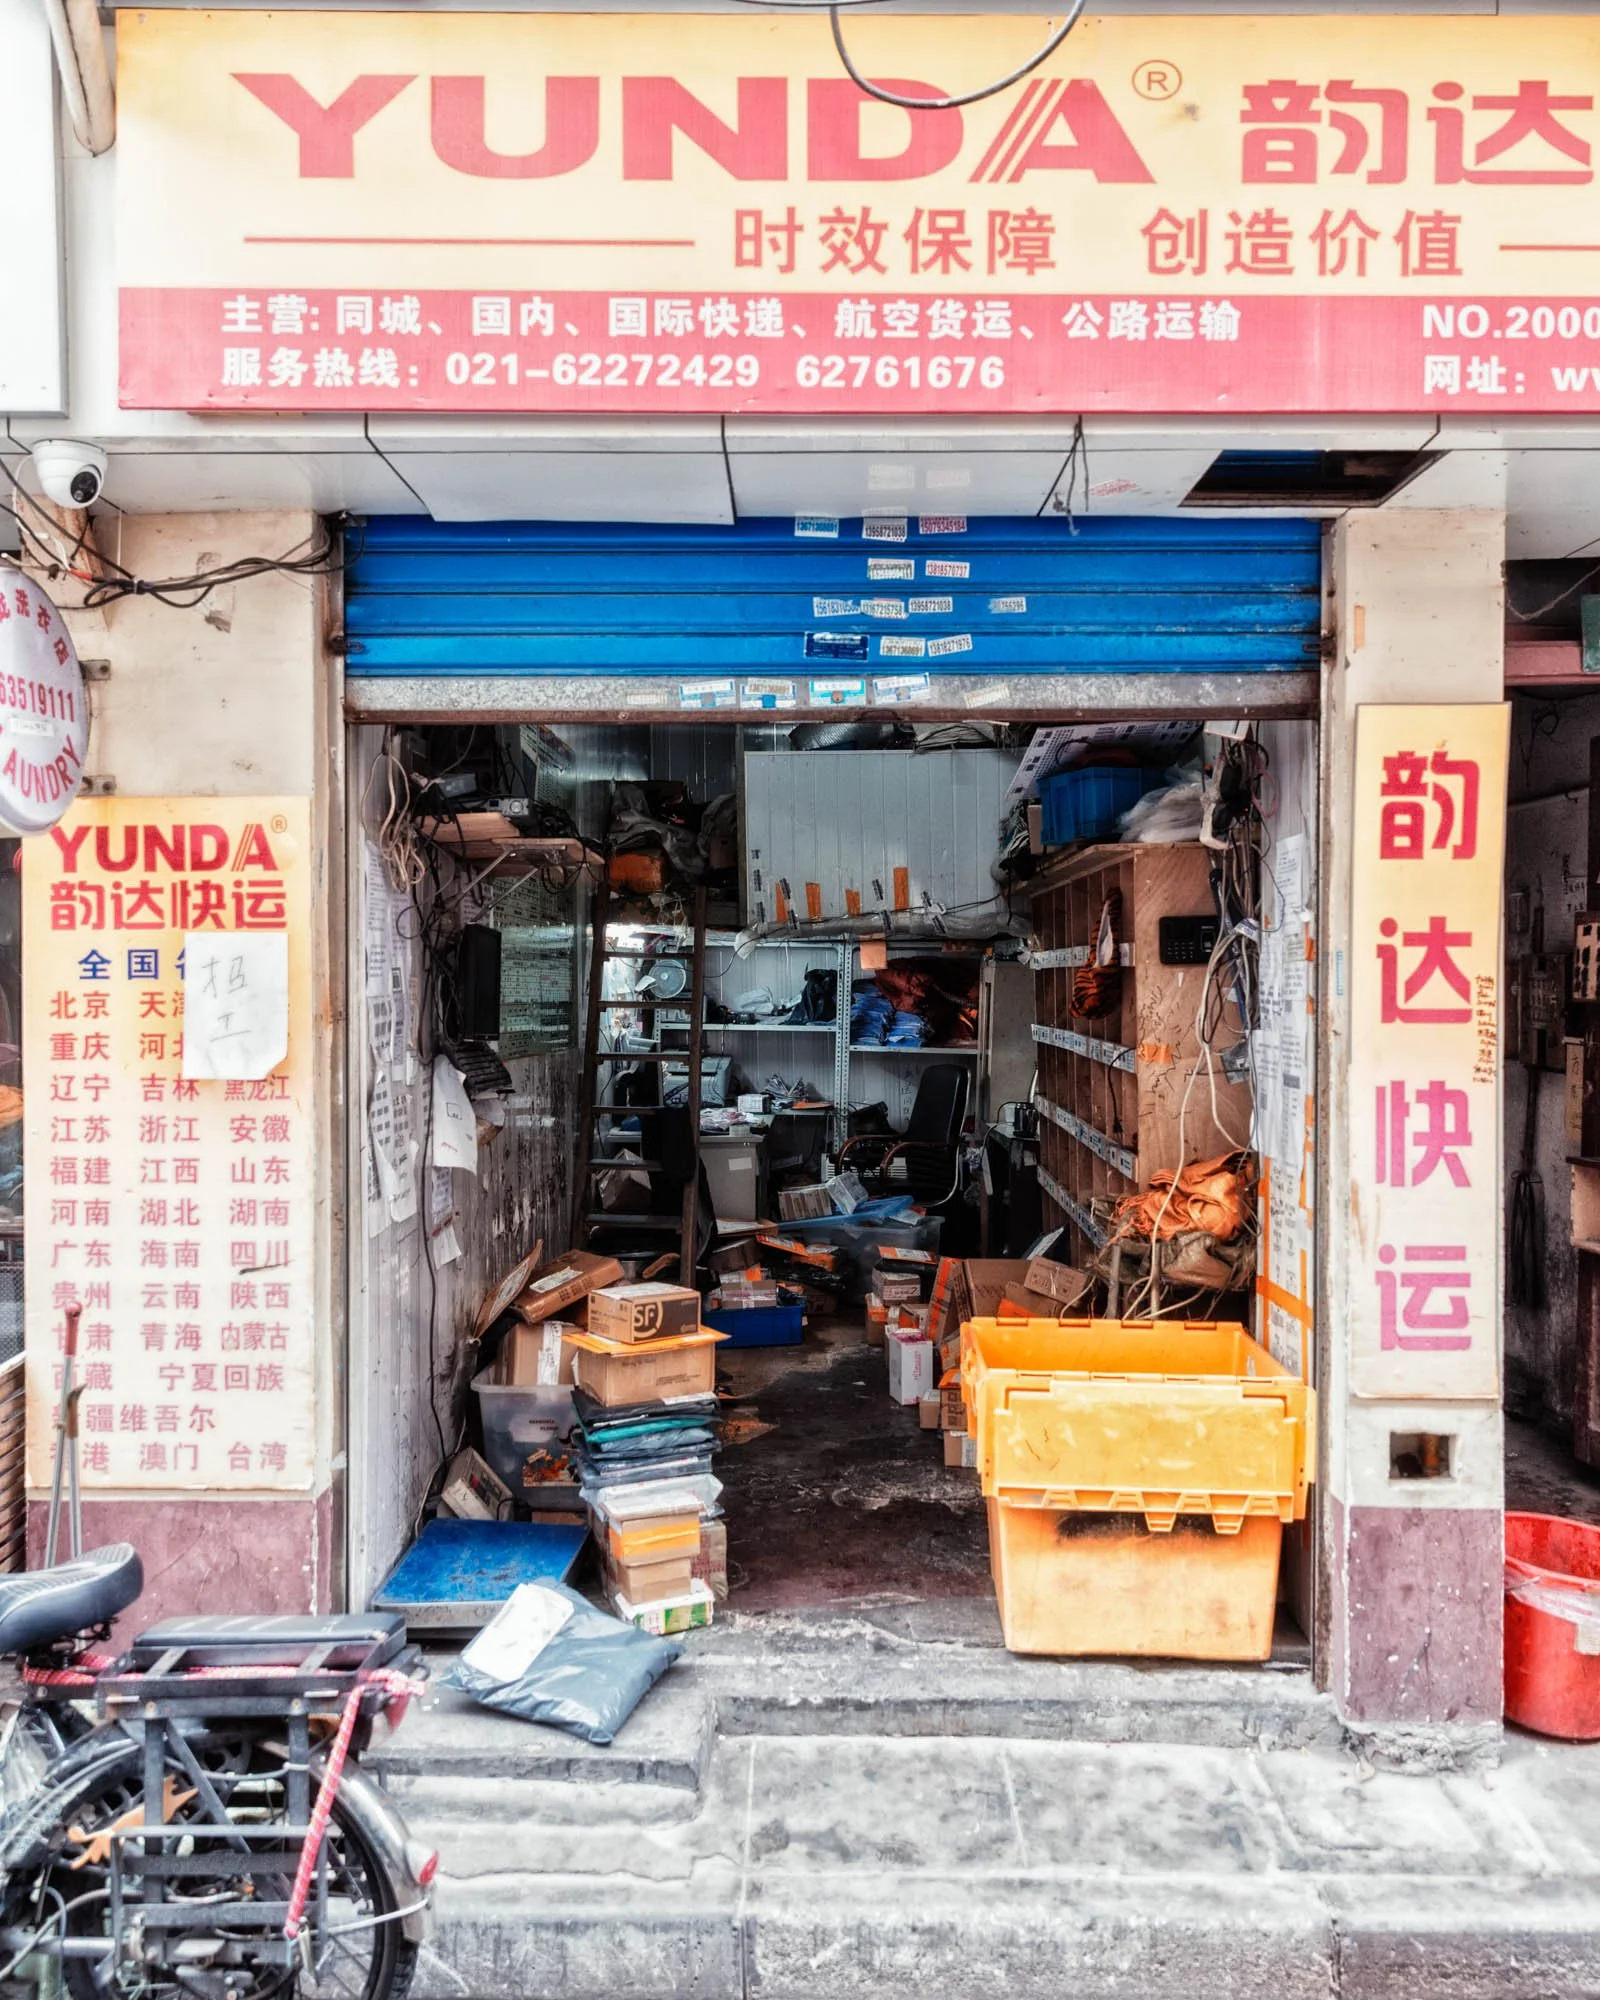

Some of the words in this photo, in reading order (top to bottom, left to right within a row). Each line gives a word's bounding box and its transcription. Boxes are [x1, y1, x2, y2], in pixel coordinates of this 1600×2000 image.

[230, 73, 1156, 184] YUNDA
[1240, 79, 1594, 186] 韵达
[734, 206, 1056, 276] 时效保障
[1140, 207, 1463, 278] 创造价值
[446, 351, 760, 388] 021-62272429
[795, 355, 1005, 390] 62761676
[1550, 366, 1600, 392] w
[50, 823, 279, 873] YUNDA
[50, 880, 288, 931] 韵达快运
[50, 991, 111, 1019] 北京
[50, 1032, 111, 1060] 重庆
[1375, 749, 1481, 1352] 韵达快运
[50, 1074, 111, 1102] 辽宁
[140, 1074, 200, 1102] 吉林
[224, 1074, 290, 1102] 黑龙江
[50, 1115, 111, 1143] 江苏
[139, 1115, 200, 1143] 浙江
[229, 1115, 290, 1143] 安徽
[50, 1156, 111, 1185] 福建
[140, 1156, 200, 1185] 江西
[231, 1156, 290, 1185] 山东
[50, 1198, 111, 1227] 河南
[139, 1198, 200, 1227] 湖北
[229, 1198, 290, 1227] 湖南
[51, 1240, 111, 1268] 广东
[140, 1240, 200, 1268] 海南
[231, 1240, 290, 1268] 四川
[52, 1282, 111, 1310] 贵州
[141, 1282, 200, 1310] 云南
[230, 1282, 290, 1310] 陕西
[140, 1323, 202, 1351] 青海
[221, 1323, 290, 1351] 内蒙古
[158, 1363, 284, 1392] 宁夏回族
[52, 1404, 216, 1433] 疆维吾尔
[139, 1441, 200, 1472] 澳门
[228, 1441, 288, 1472] 台湾
